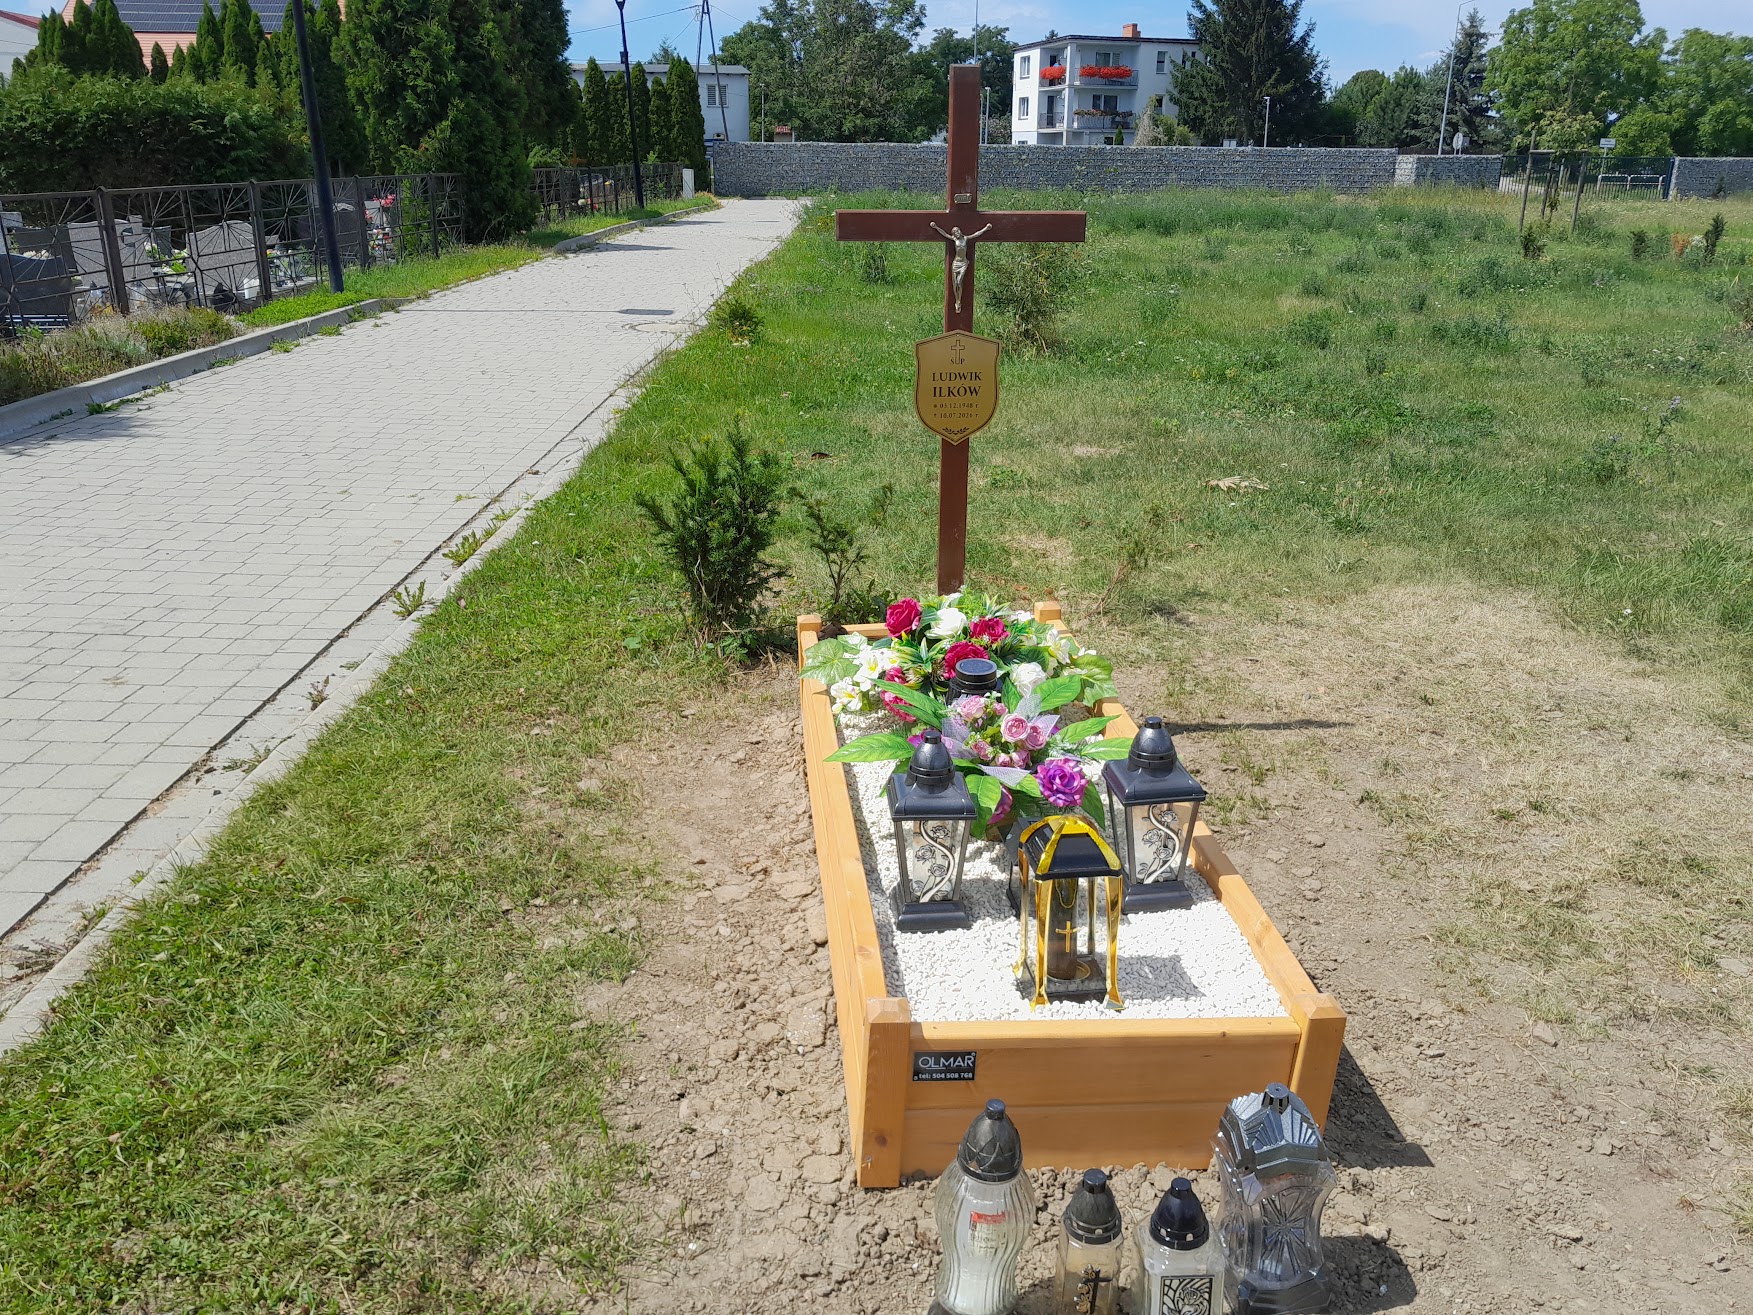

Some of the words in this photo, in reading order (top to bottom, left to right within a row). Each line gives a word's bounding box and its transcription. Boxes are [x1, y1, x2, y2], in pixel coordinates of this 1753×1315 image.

[932, 372, 982, 381] LUDWIK
[933, 383, 981, 397] ILKÓW
[919, 1056, 974, 1068] OLMAR
